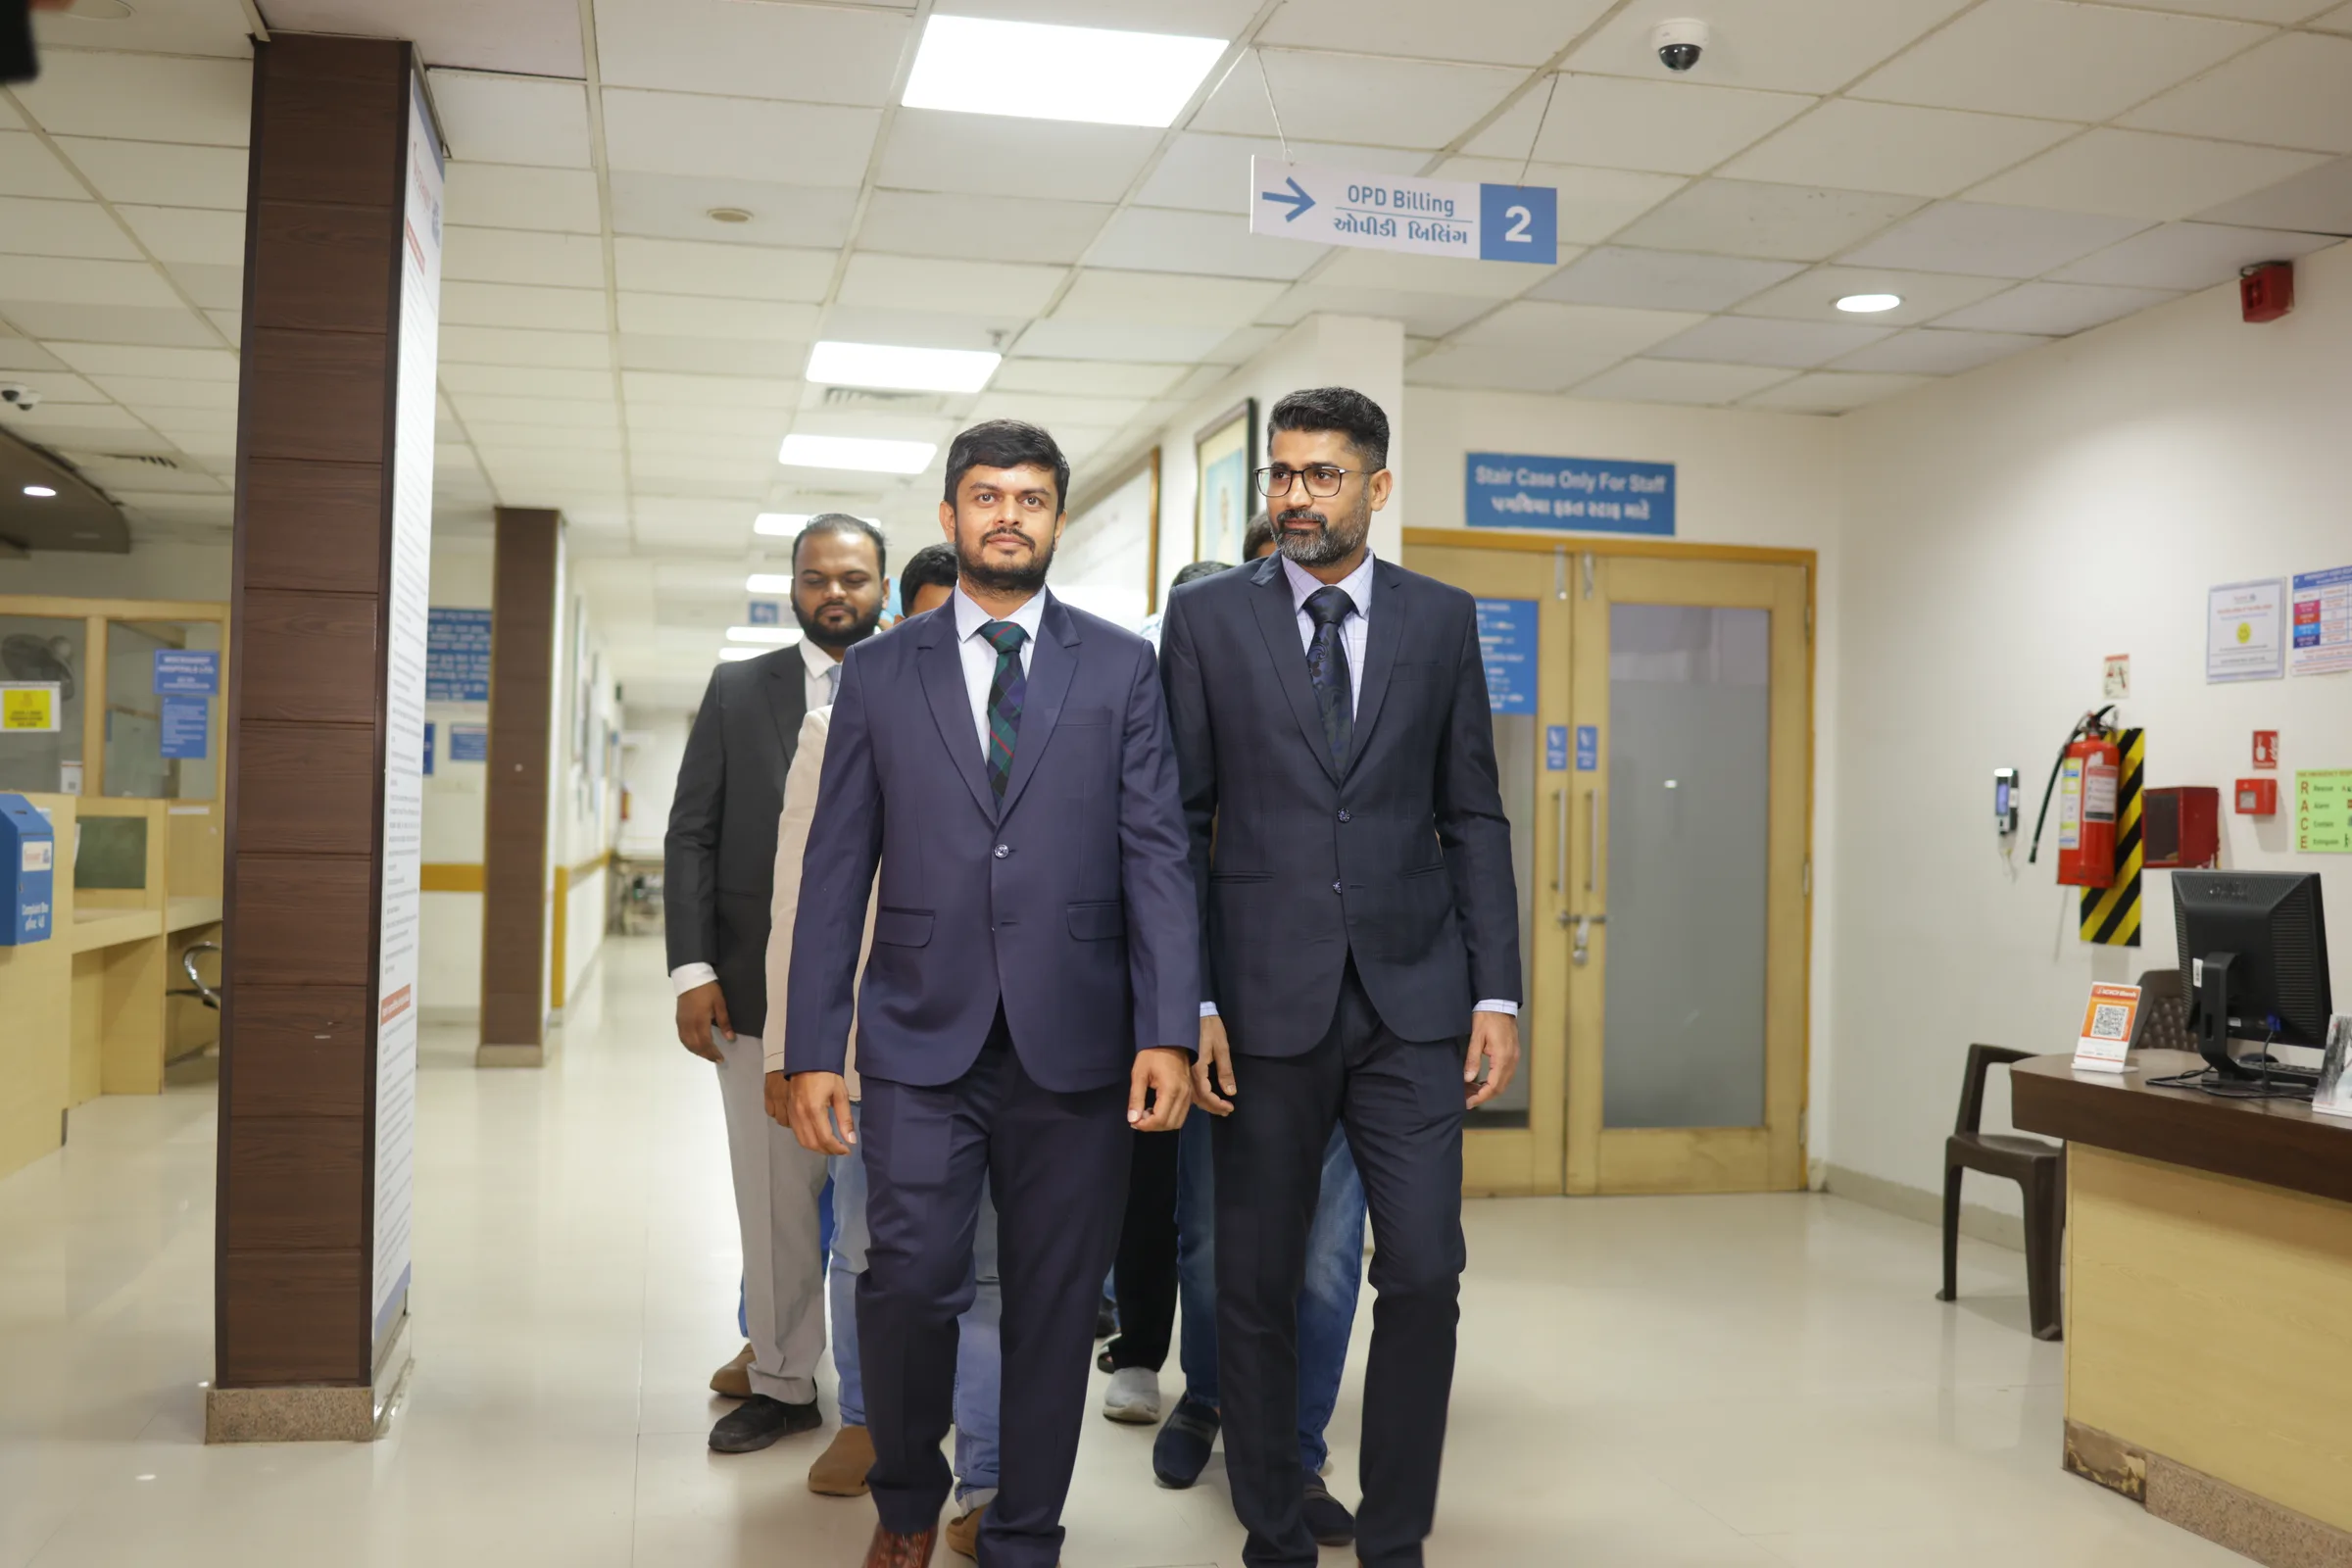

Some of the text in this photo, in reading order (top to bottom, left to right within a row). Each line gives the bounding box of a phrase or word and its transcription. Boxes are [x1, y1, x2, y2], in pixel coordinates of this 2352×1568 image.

[1348, 184, 1454, 218] OPD Billing
[1333, 213, 1396, 237] ઓપીડી
[1504, 205, 1533, 243] 2
[1475, 466, 1667, 494] Stair Case Only For Staff
[2300, 781, 2309, 795] R
[2300, 800, 2309, 812] A
[2300, 817, 2309, 831] C
[2300, 835, 2308, 850] E
